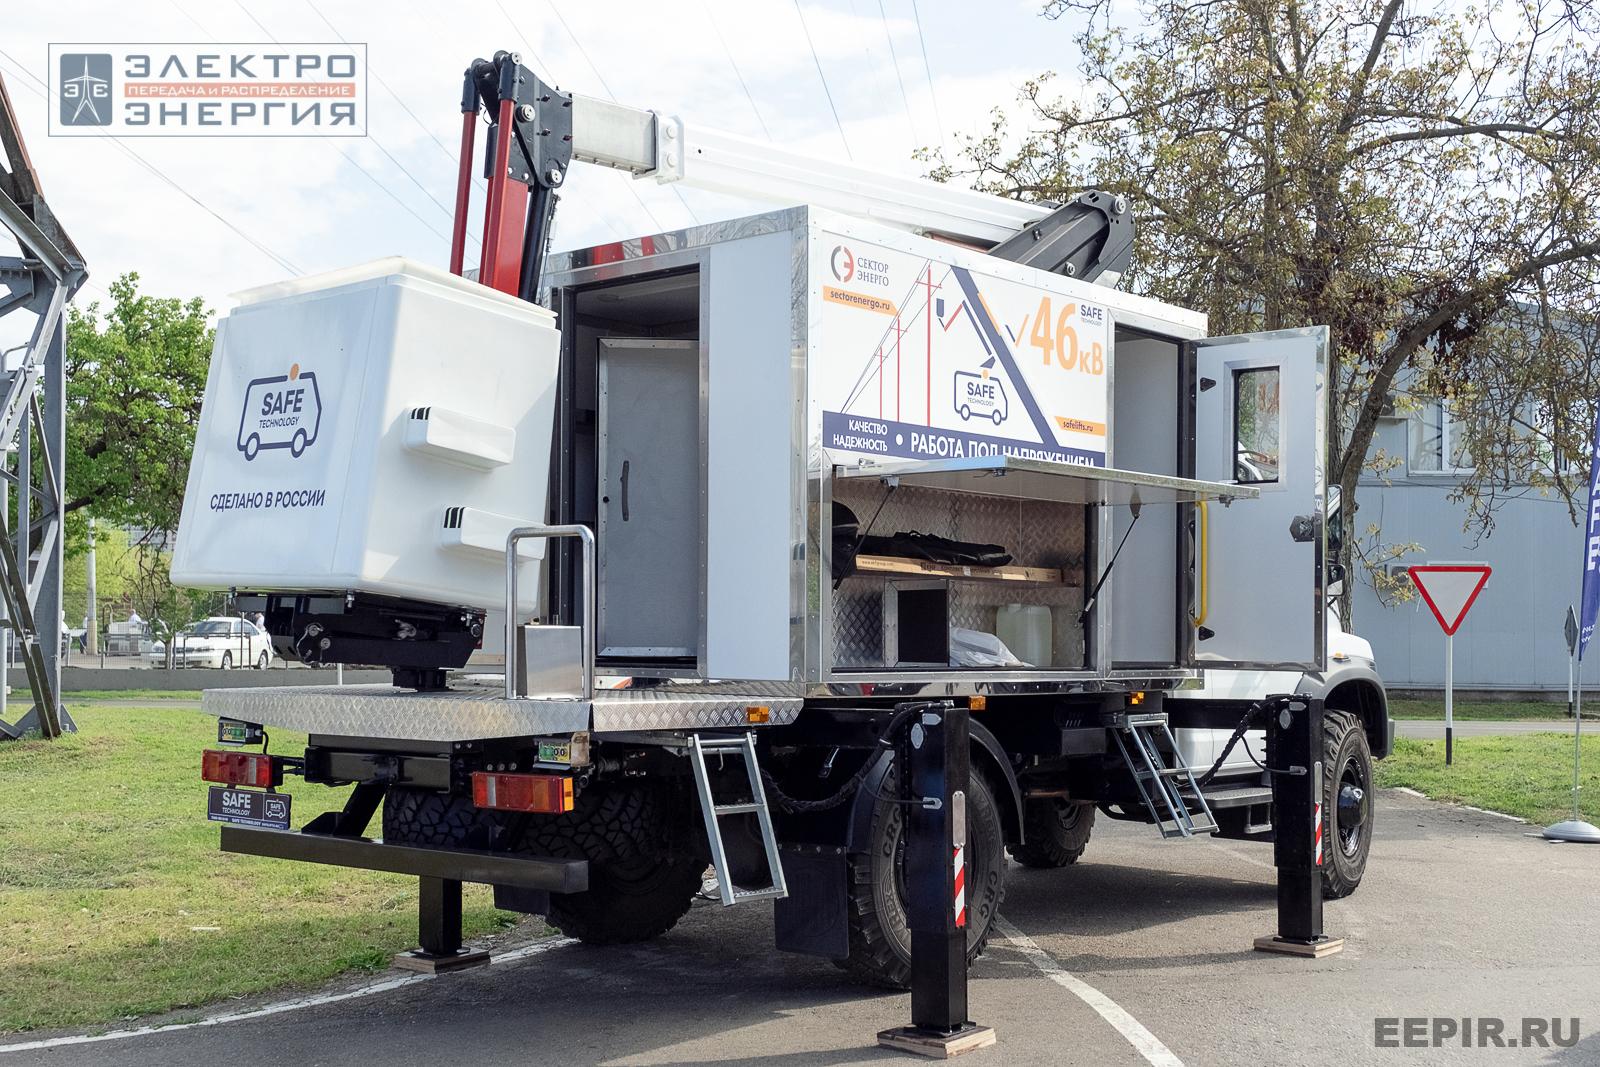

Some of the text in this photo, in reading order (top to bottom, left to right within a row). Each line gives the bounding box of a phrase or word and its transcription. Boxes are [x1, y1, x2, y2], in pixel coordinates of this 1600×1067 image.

[857, 256, 890, 274] СЕКТОР
[857, 270, 890, 287] ЭНЕРГО
[830, 290, 891, 311] sectorenergo.ru
[1080, 304, 1103, 321] SAFE
[967, 381, 995, 400] SAFE
[261, 388, 305, 417] SAFE
[258, 416, 301, 429] TECHNOLOGY
[848, 419, 888, 436] КАЧЕСТВО
[833, 434, 888, 452] НАДЕЖНОСТЬ
[910, 432, 965, 459] РАБОТА
[210, 489, 326, 513] СДЕЛАНО В РОССИИ
[222, 791, 251, 809] SAFE
[222, 806, 250, 816] TECHNOLOGY
